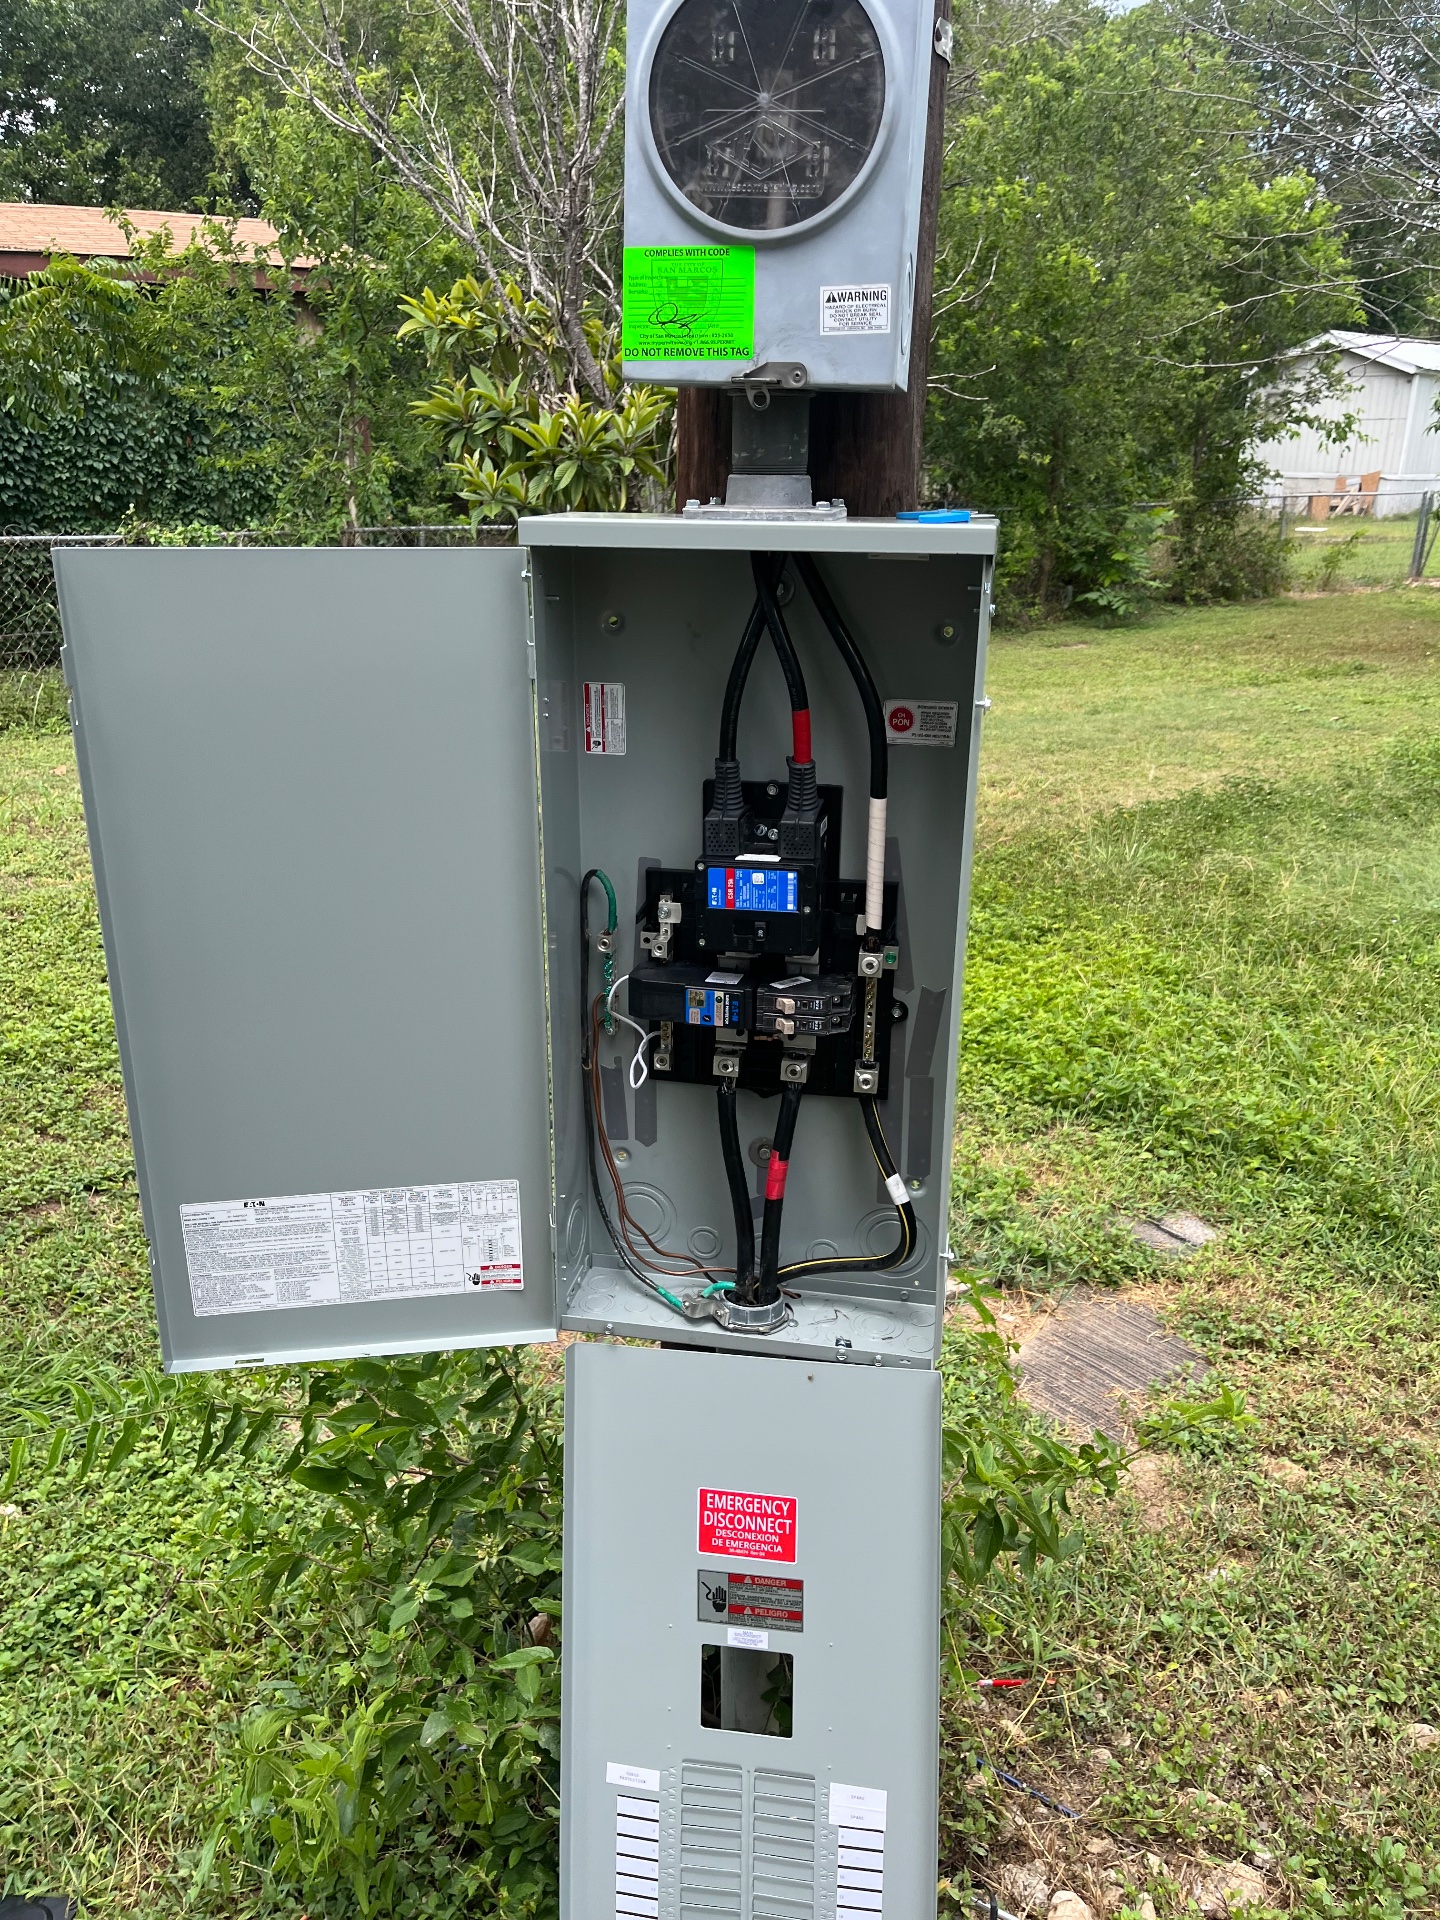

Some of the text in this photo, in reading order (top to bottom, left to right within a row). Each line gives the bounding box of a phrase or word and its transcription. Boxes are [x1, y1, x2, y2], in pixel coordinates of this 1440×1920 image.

[644, 248, 730, 257] COMPLIES WITH CODE
[678, 266, 718, 274] MARCOS
[838, 290, 887, 302] WARNING
[624, 347, 750, 356] DO NOT REMOVE THIS TAG
[707, 1493, 790, 1516] EMERGENCY
[704, 1511, 792, 1534] DISCONNECT
[716, 1529, 779, 1543] DESCONEXION
[712, 1538, 782, 1553] DE EMERGENCIA
[755, 1578, 786, 1586] DANGER
[755, 1608, 788, 1618] PELIGRO
